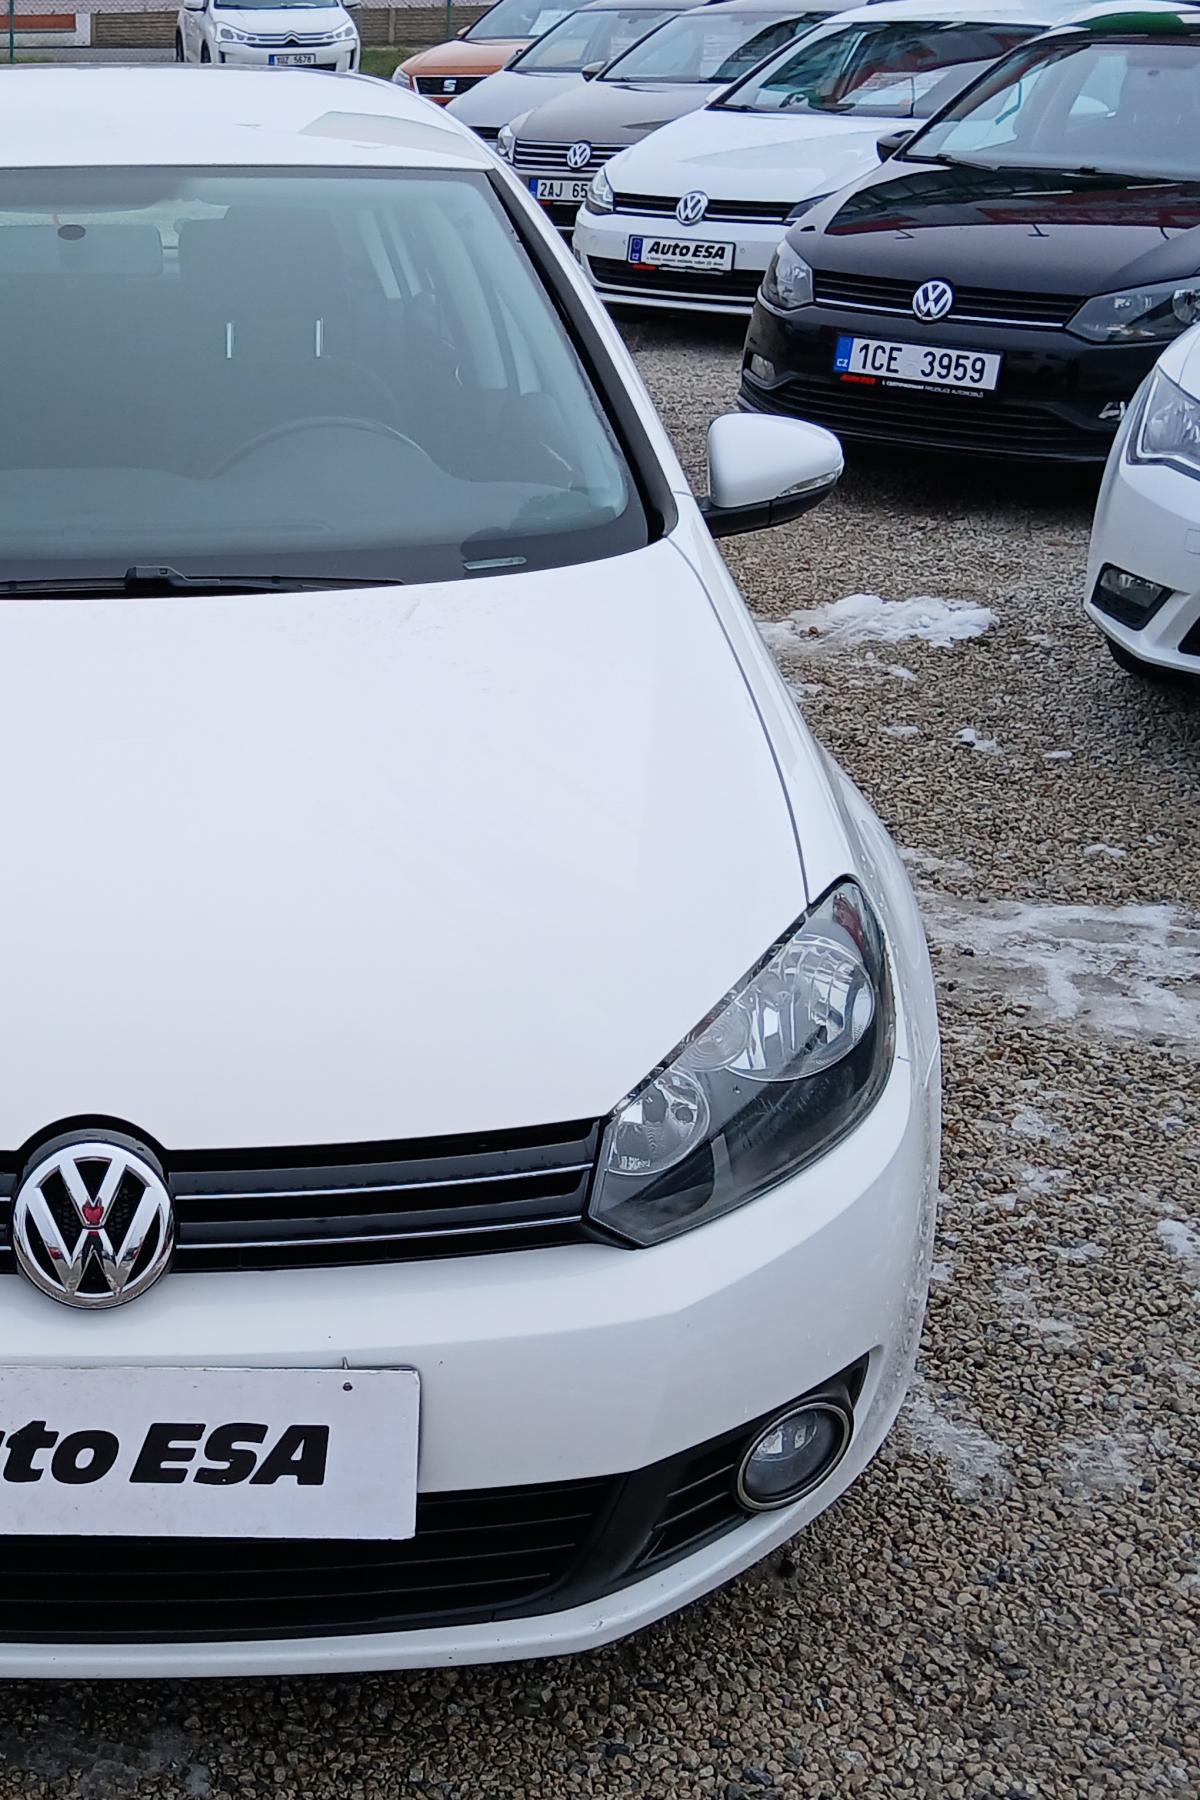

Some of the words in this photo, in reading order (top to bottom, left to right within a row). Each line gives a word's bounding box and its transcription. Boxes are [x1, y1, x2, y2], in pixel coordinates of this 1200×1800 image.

[540, 182, 563, 198] 2AJ
[572, 183, 588, 198] 65
[648, 241, 690, 257] Auto
[691, 244, 726, 260] ESA
[836, 358, 849, 368] CZ
[859, 343, 903, 374] 1CE
[920, 351, 986, 383] 3959
[129, 1421, 330, 1486] ESA
